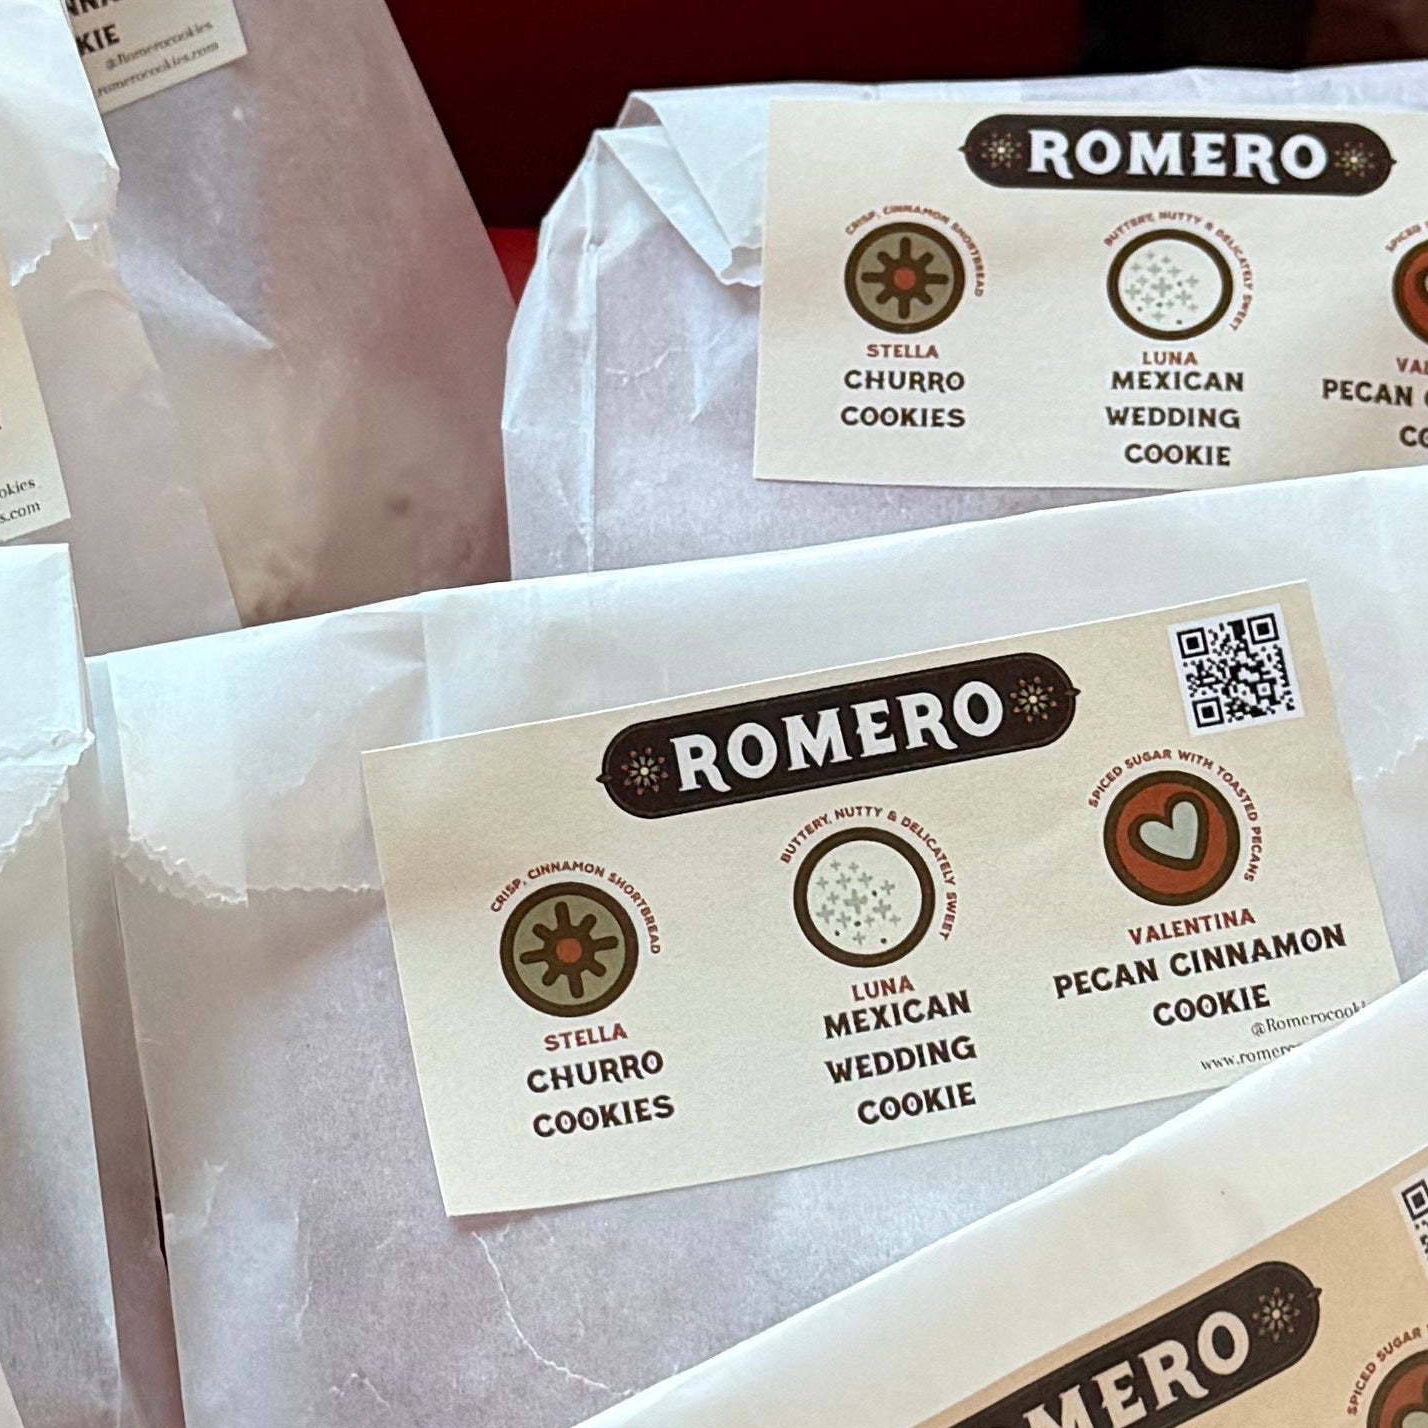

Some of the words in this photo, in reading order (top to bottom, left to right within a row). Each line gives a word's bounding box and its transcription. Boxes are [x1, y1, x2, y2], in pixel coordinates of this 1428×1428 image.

[75, 24, 120, 57] KIE
[1027, 127, 1326, 185] ROMERO
[865, 342, 941, 360] STELLA
[1142, 350, 1199, 367] LUNA
[842, 368, 966, 395] CHURRO
[1110, 370, 1245, 392] MEXICAN
[1321, 378, 1413, 407] PECAN
[839, 404, 967, 430] COOKIES
[1104, 406, 1241, 429] WEDDING
[1123, 444, 1232, 465] COOKIE
[669, 680, 1004, 793] ROMERO
[1087, 765, 1123, 809] SPICED
[1123, 748, 1172, 770] SUGAR
[1177, 749, 1214, 771] WITH
[1216, 765, 1258, 822] TOASTED
[1243, 825, 1263, 883] PECANS
[833, 805, 883, 820] NUTTY
[900, 815, 956, 886] DELICATELY
[939, 891, 958, 941] SWEET
[526, 860, 606, 880] CINNAMON
[607, 872, 662, 955] SHORTBREAD
[1127, 907, 1257, 946] VALENTINA
[1052, 957, 1160, 1000] PECAN
[1169, 922, 1347, 978] CINNAMON
[851, 974, 916, 1003] LUNA
[1152, 983, 1271, 1027] COOKIE
[823, 989, 972, 1040] MEXICAN
[1251, 1000, 1366, 1037] @Romerocook
[543, 1022, 629, 1052] STELLA
[526, 1049, 664, 1094] CHURRO
[823, 1034, 978, 1085] WEDDING
[532, 1094, 675, 1139] COOKIES
[857, 1081, 977, 1126] COOKIE
[1347, 1361, 1376, 1416] SPICED
[1376, 1326, 1423, 1363] SUGAR
